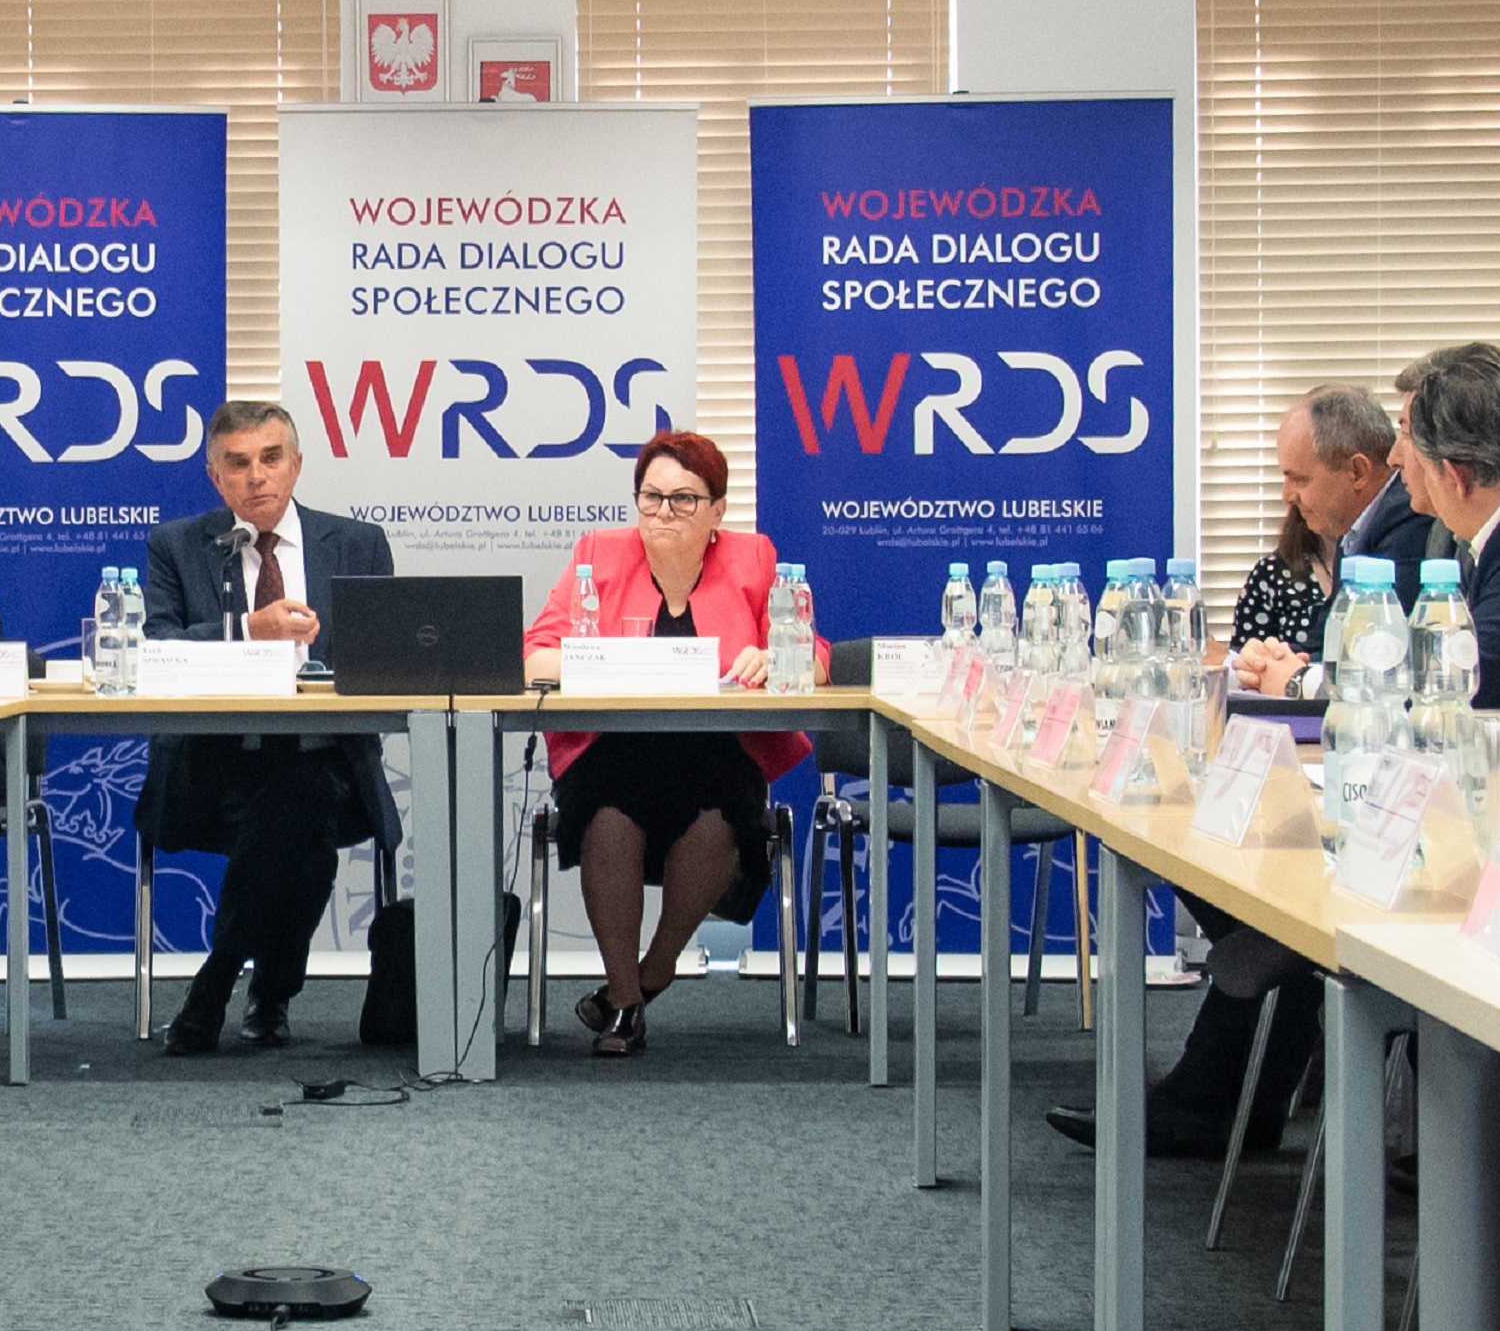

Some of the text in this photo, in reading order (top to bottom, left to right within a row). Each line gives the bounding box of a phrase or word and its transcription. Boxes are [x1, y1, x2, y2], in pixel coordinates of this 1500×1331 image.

[349, 190, 627, 226] WOJEWÓDZKA
[821, 182, 1103, 222] WOJEWÓDZKA
[352, 241, 625, 270] RADA DIALOGU
[822, 232, 1101, 265] RADA DIALOGU
[351, 286, 626, 316] SPOŁECZNEGO
[821, 277, 1102, 311] SPOŁECZNEGO
[305, 357, 673, 459] WRDS
[777, 350, 1150, 455] WRDS
[60, 506, 161, 526] LUBELSKIE
[350, 501, 627, 523] WOJEWÓDZTWO LUBELSKIE
[821, 496, 1103, 519] WOJEWÓDZTWO LUBELSKIE
